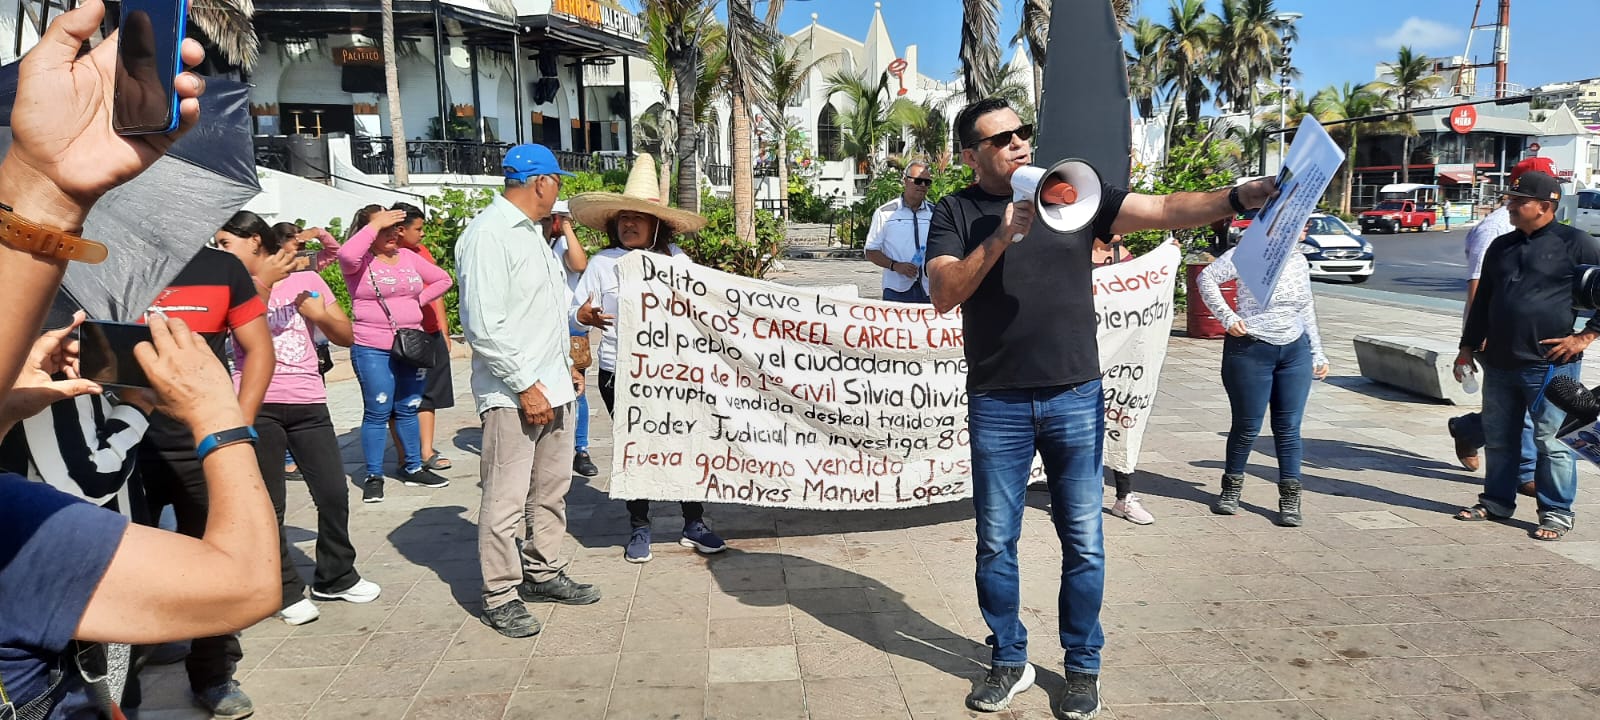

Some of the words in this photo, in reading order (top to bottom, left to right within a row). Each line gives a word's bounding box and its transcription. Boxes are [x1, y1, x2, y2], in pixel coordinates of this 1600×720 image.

[556, 0, 601, 24] TERRAZA
[600, 5, 641, 34] VALENTINO
[641, 254, 707, 297] Delito
[725, 287, 802, 317] grave
[815, 294, 838, 317] la
[636, 321, 669, 348] del
[794, 350, 923, 376] ciudadano
[752, 317, 834, 346] CARCEL
[843, 325, 919, 350] CARCEL
[630, 353, 704, 387] Jueza
[711, 364, 729, 387] de
[791, 377, 836, 403] civil
[844, 378, 904, 407] Silvia
[630, 383, 716, 406] corrupta
[725, 394, 793, 414] vendida
[804, 404, 870, 429] desleal
[877, 409, 954, 430] traidora
[627, 406, 698, 435] Poder
[709, 413, 788, 447] Judicial
[828, 432, 928, 459] investiga
[622, 441, 683, 473] Fuera
[695, 446, 796, 486] gobierno
[923, 458, 972, 485] Jus
[704, 473, 793, 503] Andres
[802, 478, 880, 503] Manuel
[895, 475, 967, 506] Lopez
